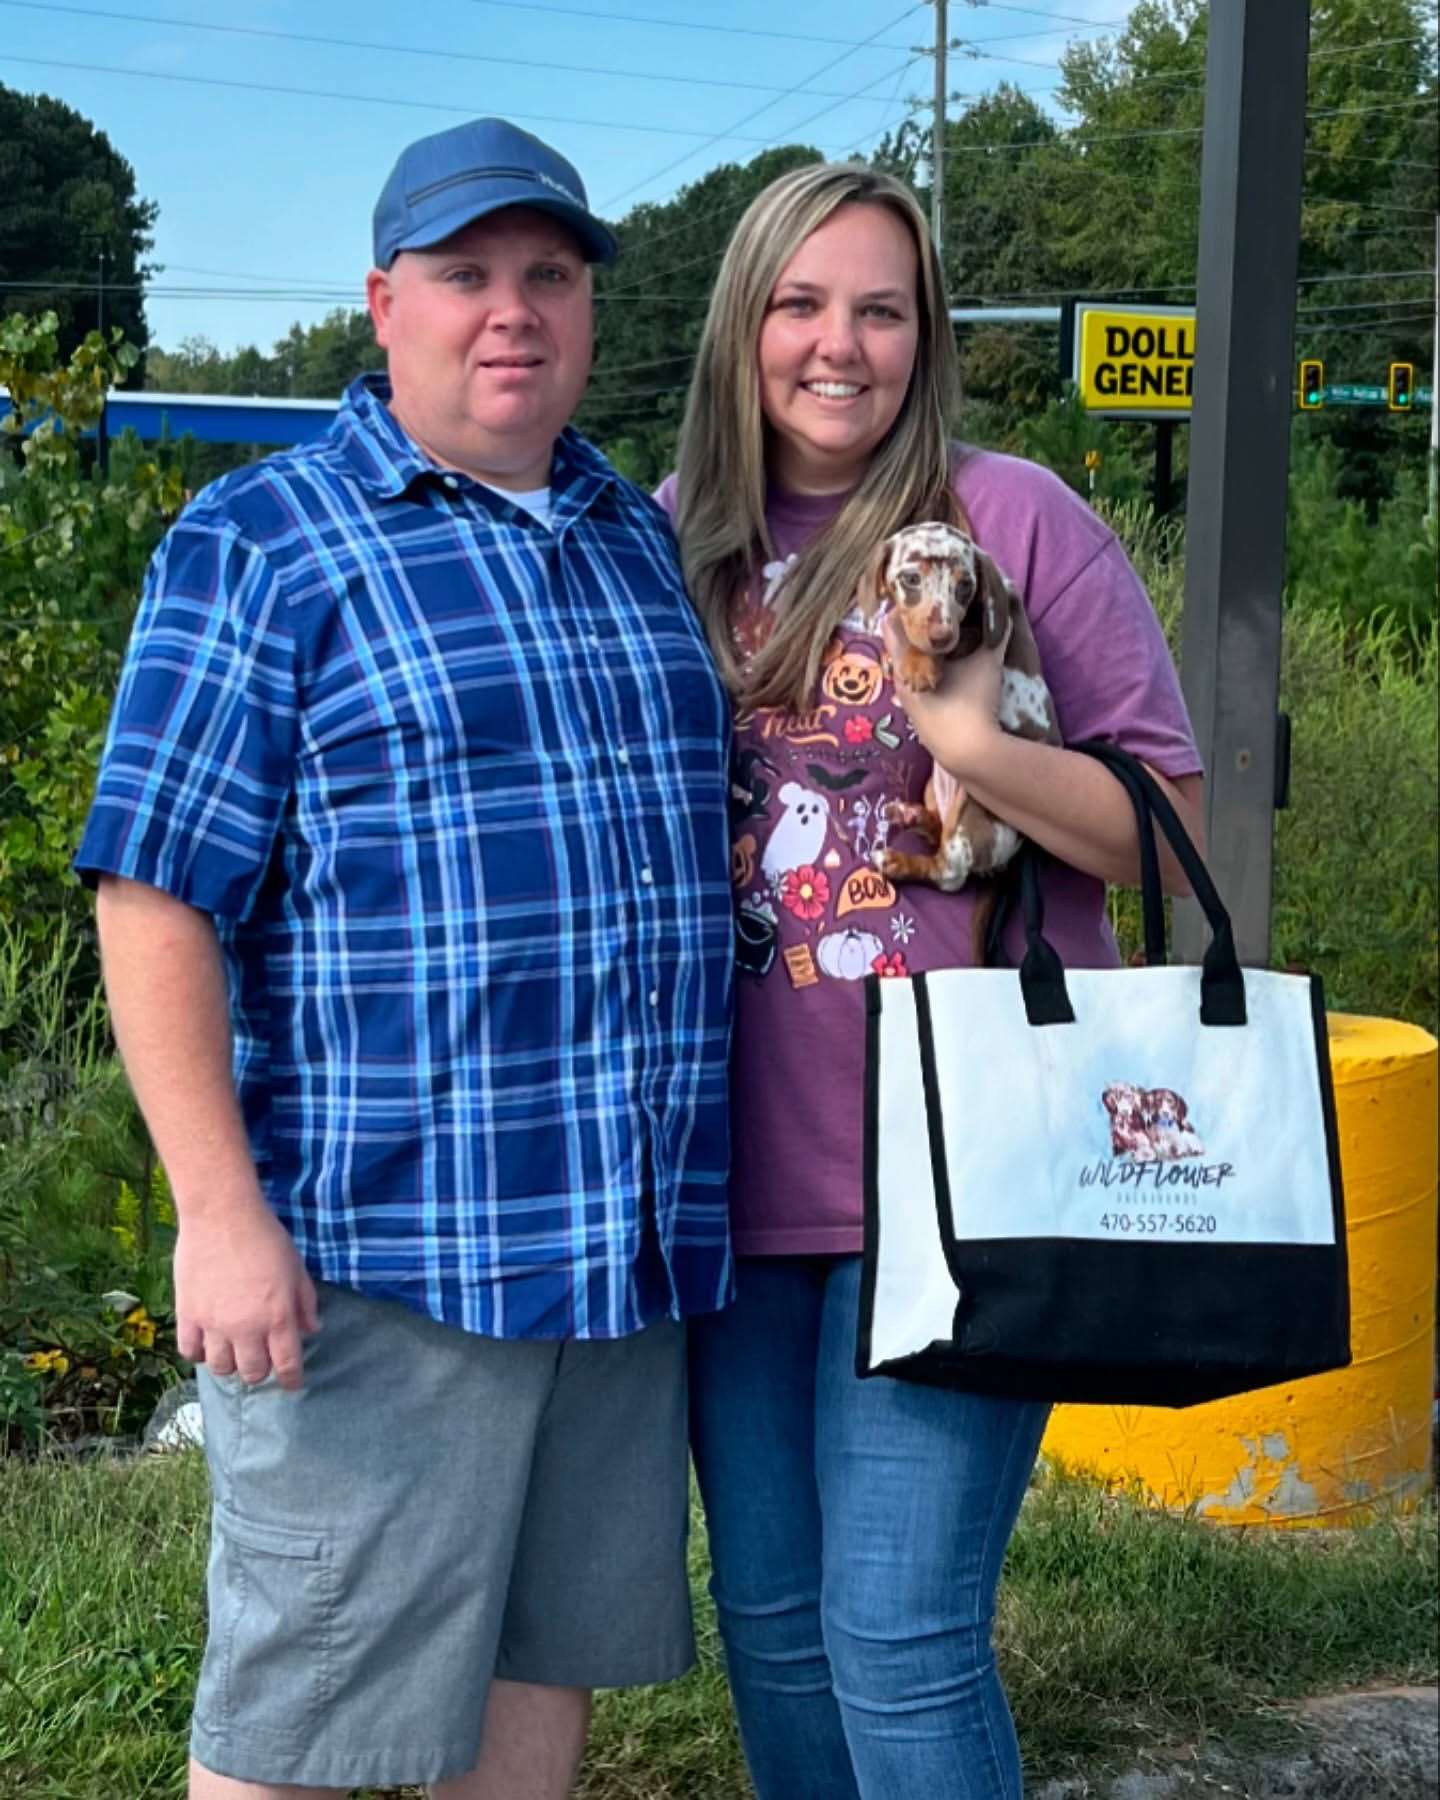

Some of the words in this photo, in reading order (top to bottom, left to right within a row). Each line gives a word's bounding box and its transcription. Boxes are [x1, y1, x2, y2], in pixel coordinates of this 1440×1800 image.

[1105, 326, 1195, 359] DOLL
[1078, 1159, 1236, 1189] WILDFLOWER
[1099, 1213, 1217, 1234] 470-557-5620
